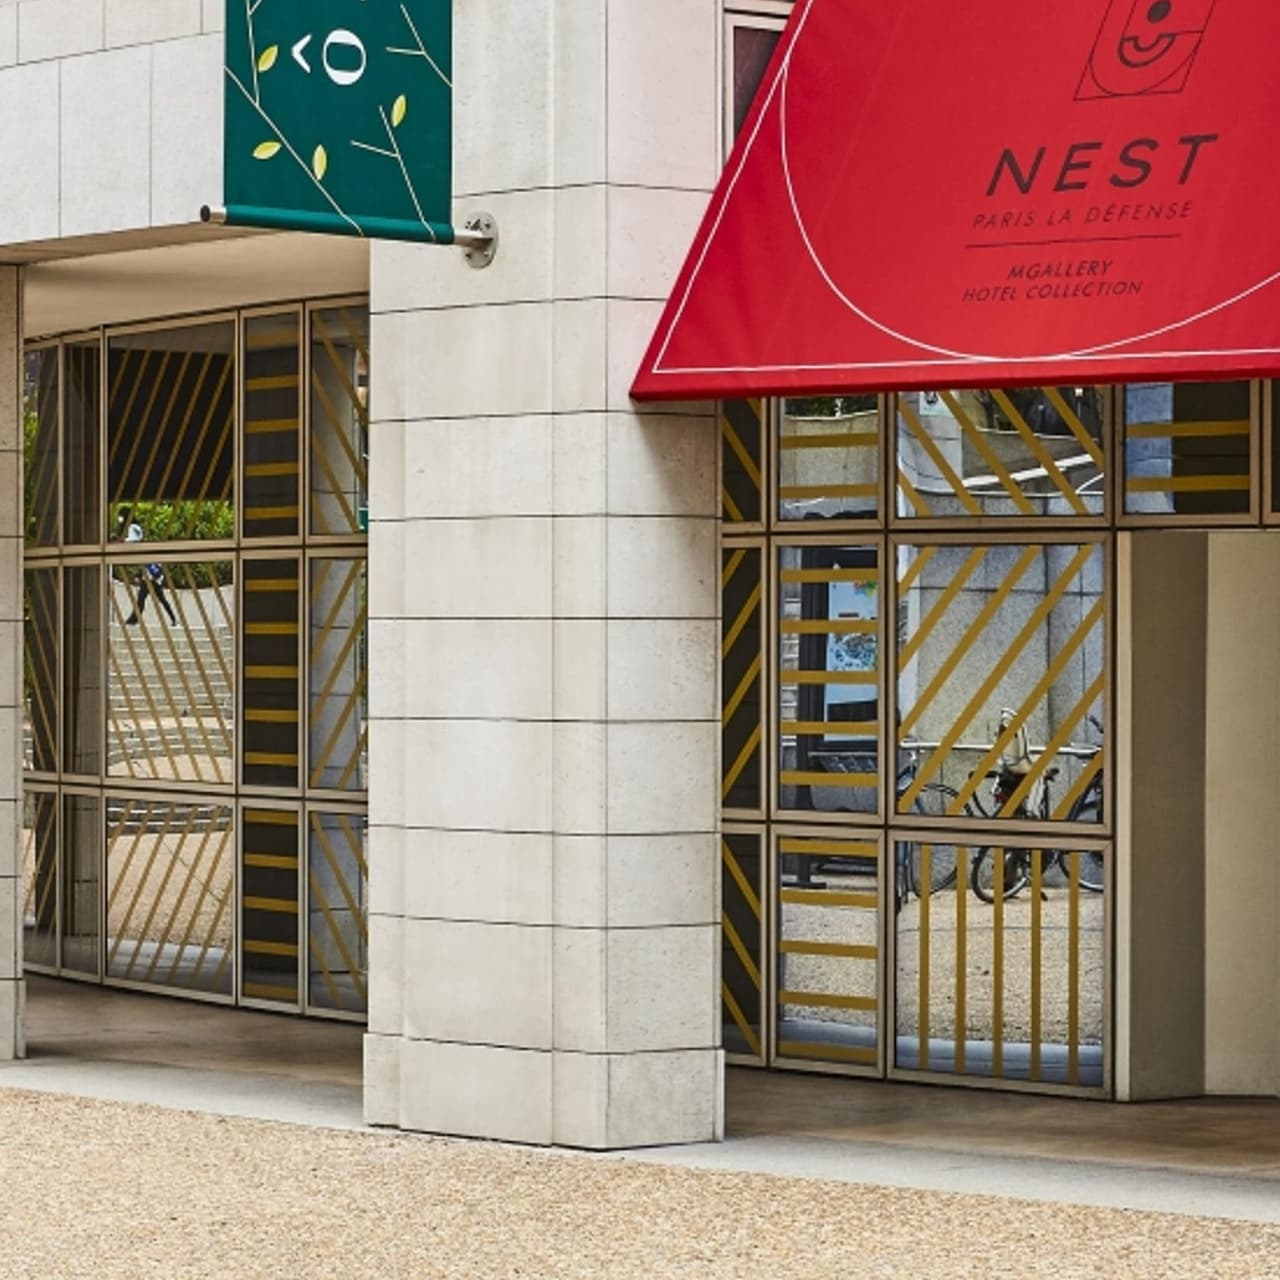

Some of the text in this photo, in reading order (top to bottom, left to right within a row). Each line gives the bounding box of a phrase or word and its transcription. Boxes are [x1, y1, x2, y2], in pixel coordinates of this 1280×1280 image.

[291, 28, 368, 86] ô
[986, 134, 1219, 196] NEST
[971, 200, 1194, 230] PARIS LA DÉFENSE
[1006, 259, 1115, 281] MGALLERY
[962, 280, 1143, 303] HOTEL COLLECTION
